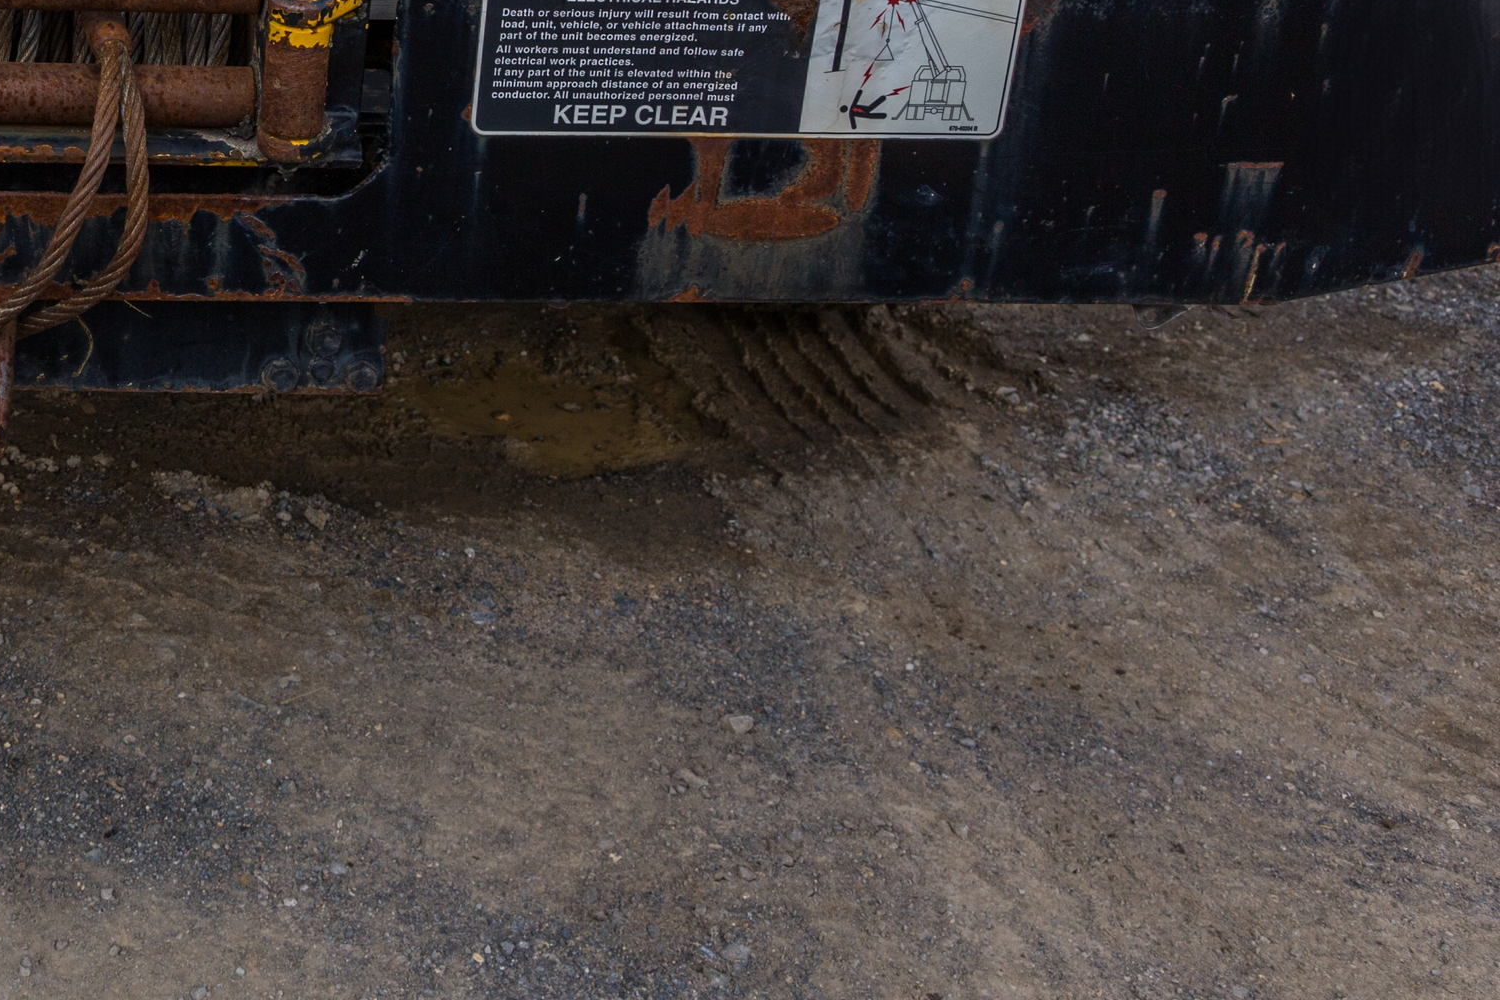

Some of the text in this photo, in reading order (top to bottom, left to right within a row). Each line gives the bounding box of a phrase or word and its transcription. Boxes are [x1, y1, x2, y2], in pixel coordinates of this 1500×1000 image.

[502, 7, 534, 17] Death
[538, 9, 550, 17] or
[553, 8, 595, 18] serious
[598, 8, 631, 20] injury
[634, 9, 654, 19] will
[657, 9, 690, 19] result
[693, 10, 719, 20] from
[722, 11, 764, 21] contact
[501, 19, 768, 34] load, unit, vehicle, or vehicle attachments if any
[499, 31, 698, 43] part of the unit becomes energized.
[496, 44, 745, 57] All workers must understand and follow safe
[494, 56, 635, 68] electrical work practices.
[493, 67, 733, 80] If any part of the unit is elevated within the
[492, 79, 739, 92] minimum approach distance of an energized
[491, 90, 735, 102] conductor. All unauthorized personnel must
[553, 104, 729, 127] KEEP CLEAR
